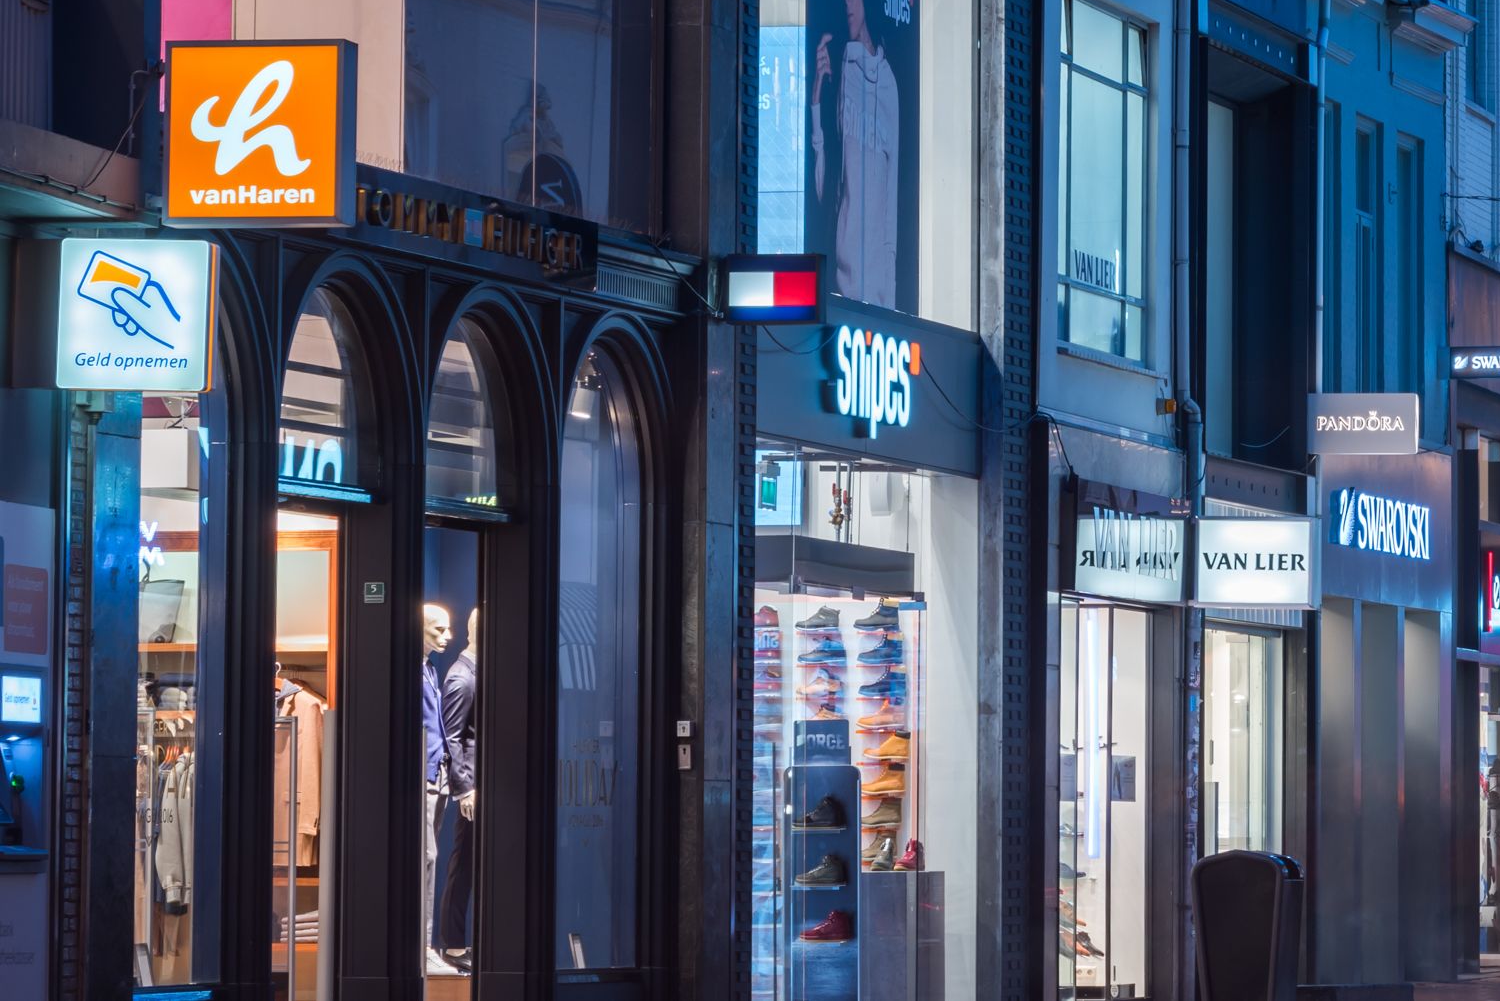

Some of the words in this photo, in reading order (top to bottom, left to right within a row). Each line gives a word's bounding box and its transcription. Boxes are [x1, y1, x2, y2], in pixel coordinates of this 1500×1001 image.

[189, 185, 316, 205] vanHaren
[492, 210, 584, 271] HILFIGER
[1074, 248, 1094, 285] VAN
[1095, 256, 1117, 293] LIER
[75, 352, 111, 367] Geld
[114, 357, 188, 371] opnemen
[837, 325, 911, 439] snipes
[1316, 411, 1405, 431] PANDORA
[1357, 493, 1430, 560] SWAROVSKI
[1093, 505, 1133, 573] VAN
[1139, 515, 1178, 582] LIER
[1203, 552, 1248, 571] VAN
[1254, 553, 1306, 571] LIER
[370, 584, 377, 593] 5
